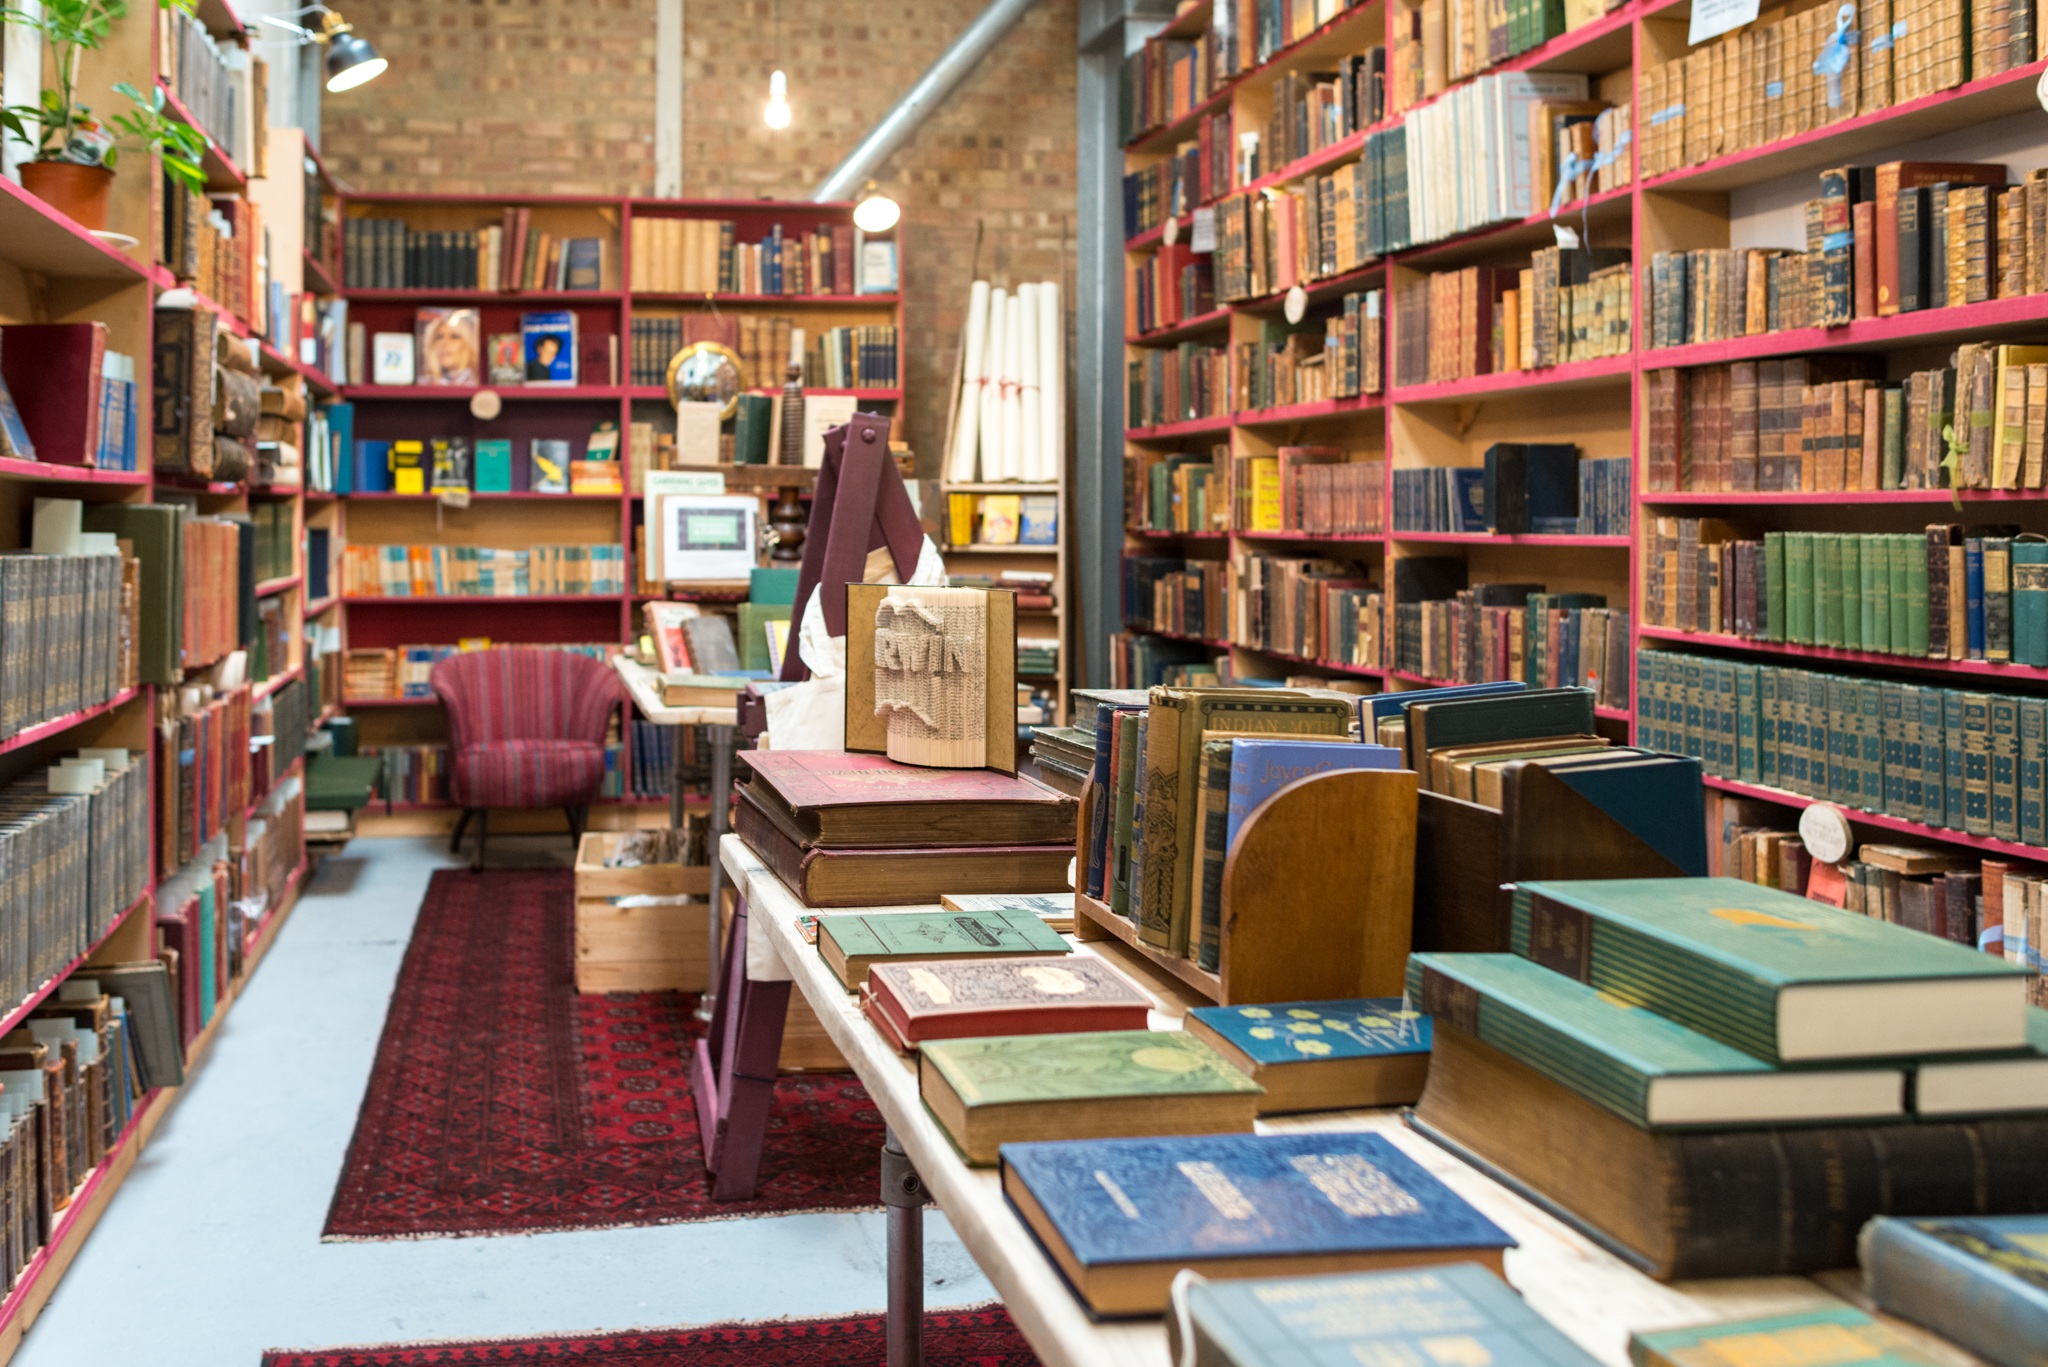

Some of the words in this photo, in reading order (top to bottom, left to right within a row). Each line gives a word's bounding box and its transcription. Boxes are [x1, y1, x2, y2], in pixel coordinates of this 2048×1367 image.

[1212, 717, 1279, 733] INDIAN
[1291, 719, 1337, 735] MYTH
[1260, 759, 1313, 788] Joyce
